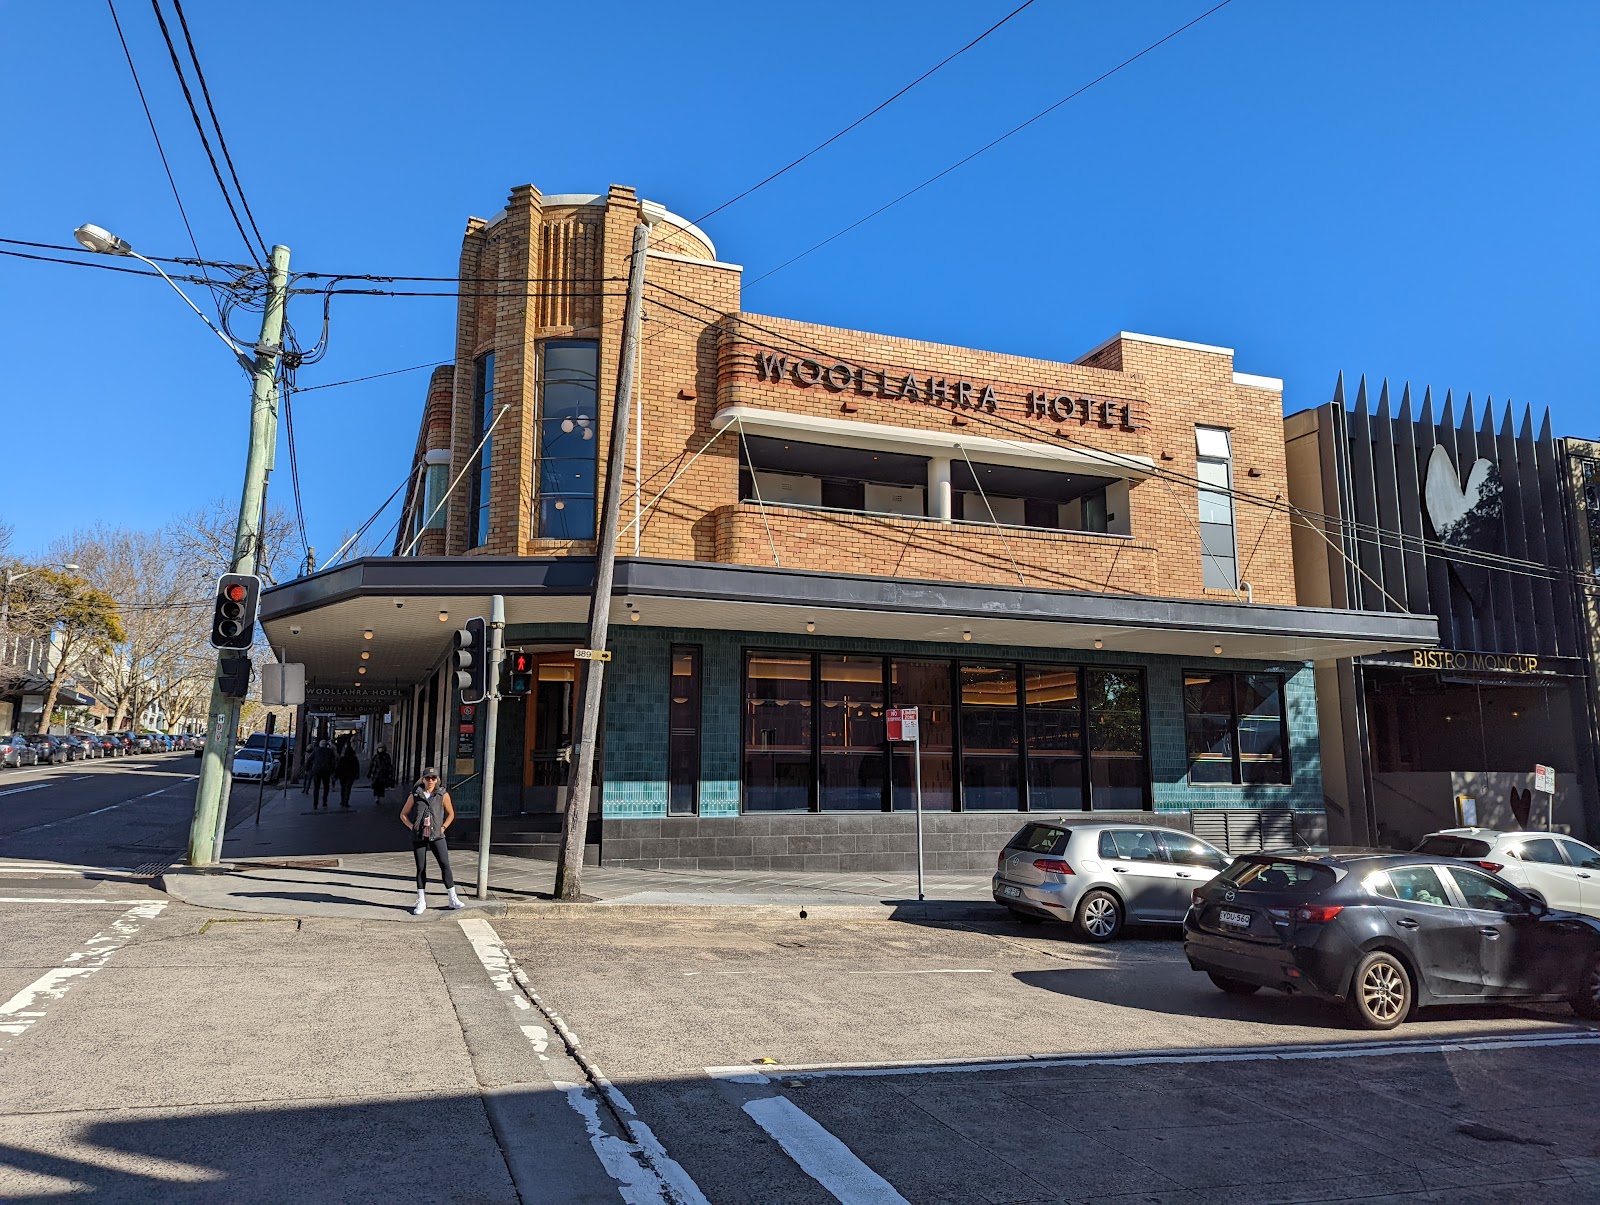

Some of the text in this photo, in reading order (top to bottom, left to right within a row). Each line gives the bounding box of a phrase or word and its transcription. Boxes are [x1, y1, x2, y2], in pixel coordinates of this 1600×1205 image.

[758, 350, 1142, 429] WOOLLAHRA HOTEL
[576, 650, 591, 658] 389
[1413, 650, 1538, 673] BISTRO MONCUR
[305, 688, 369, 696] WOOLLAHRA
